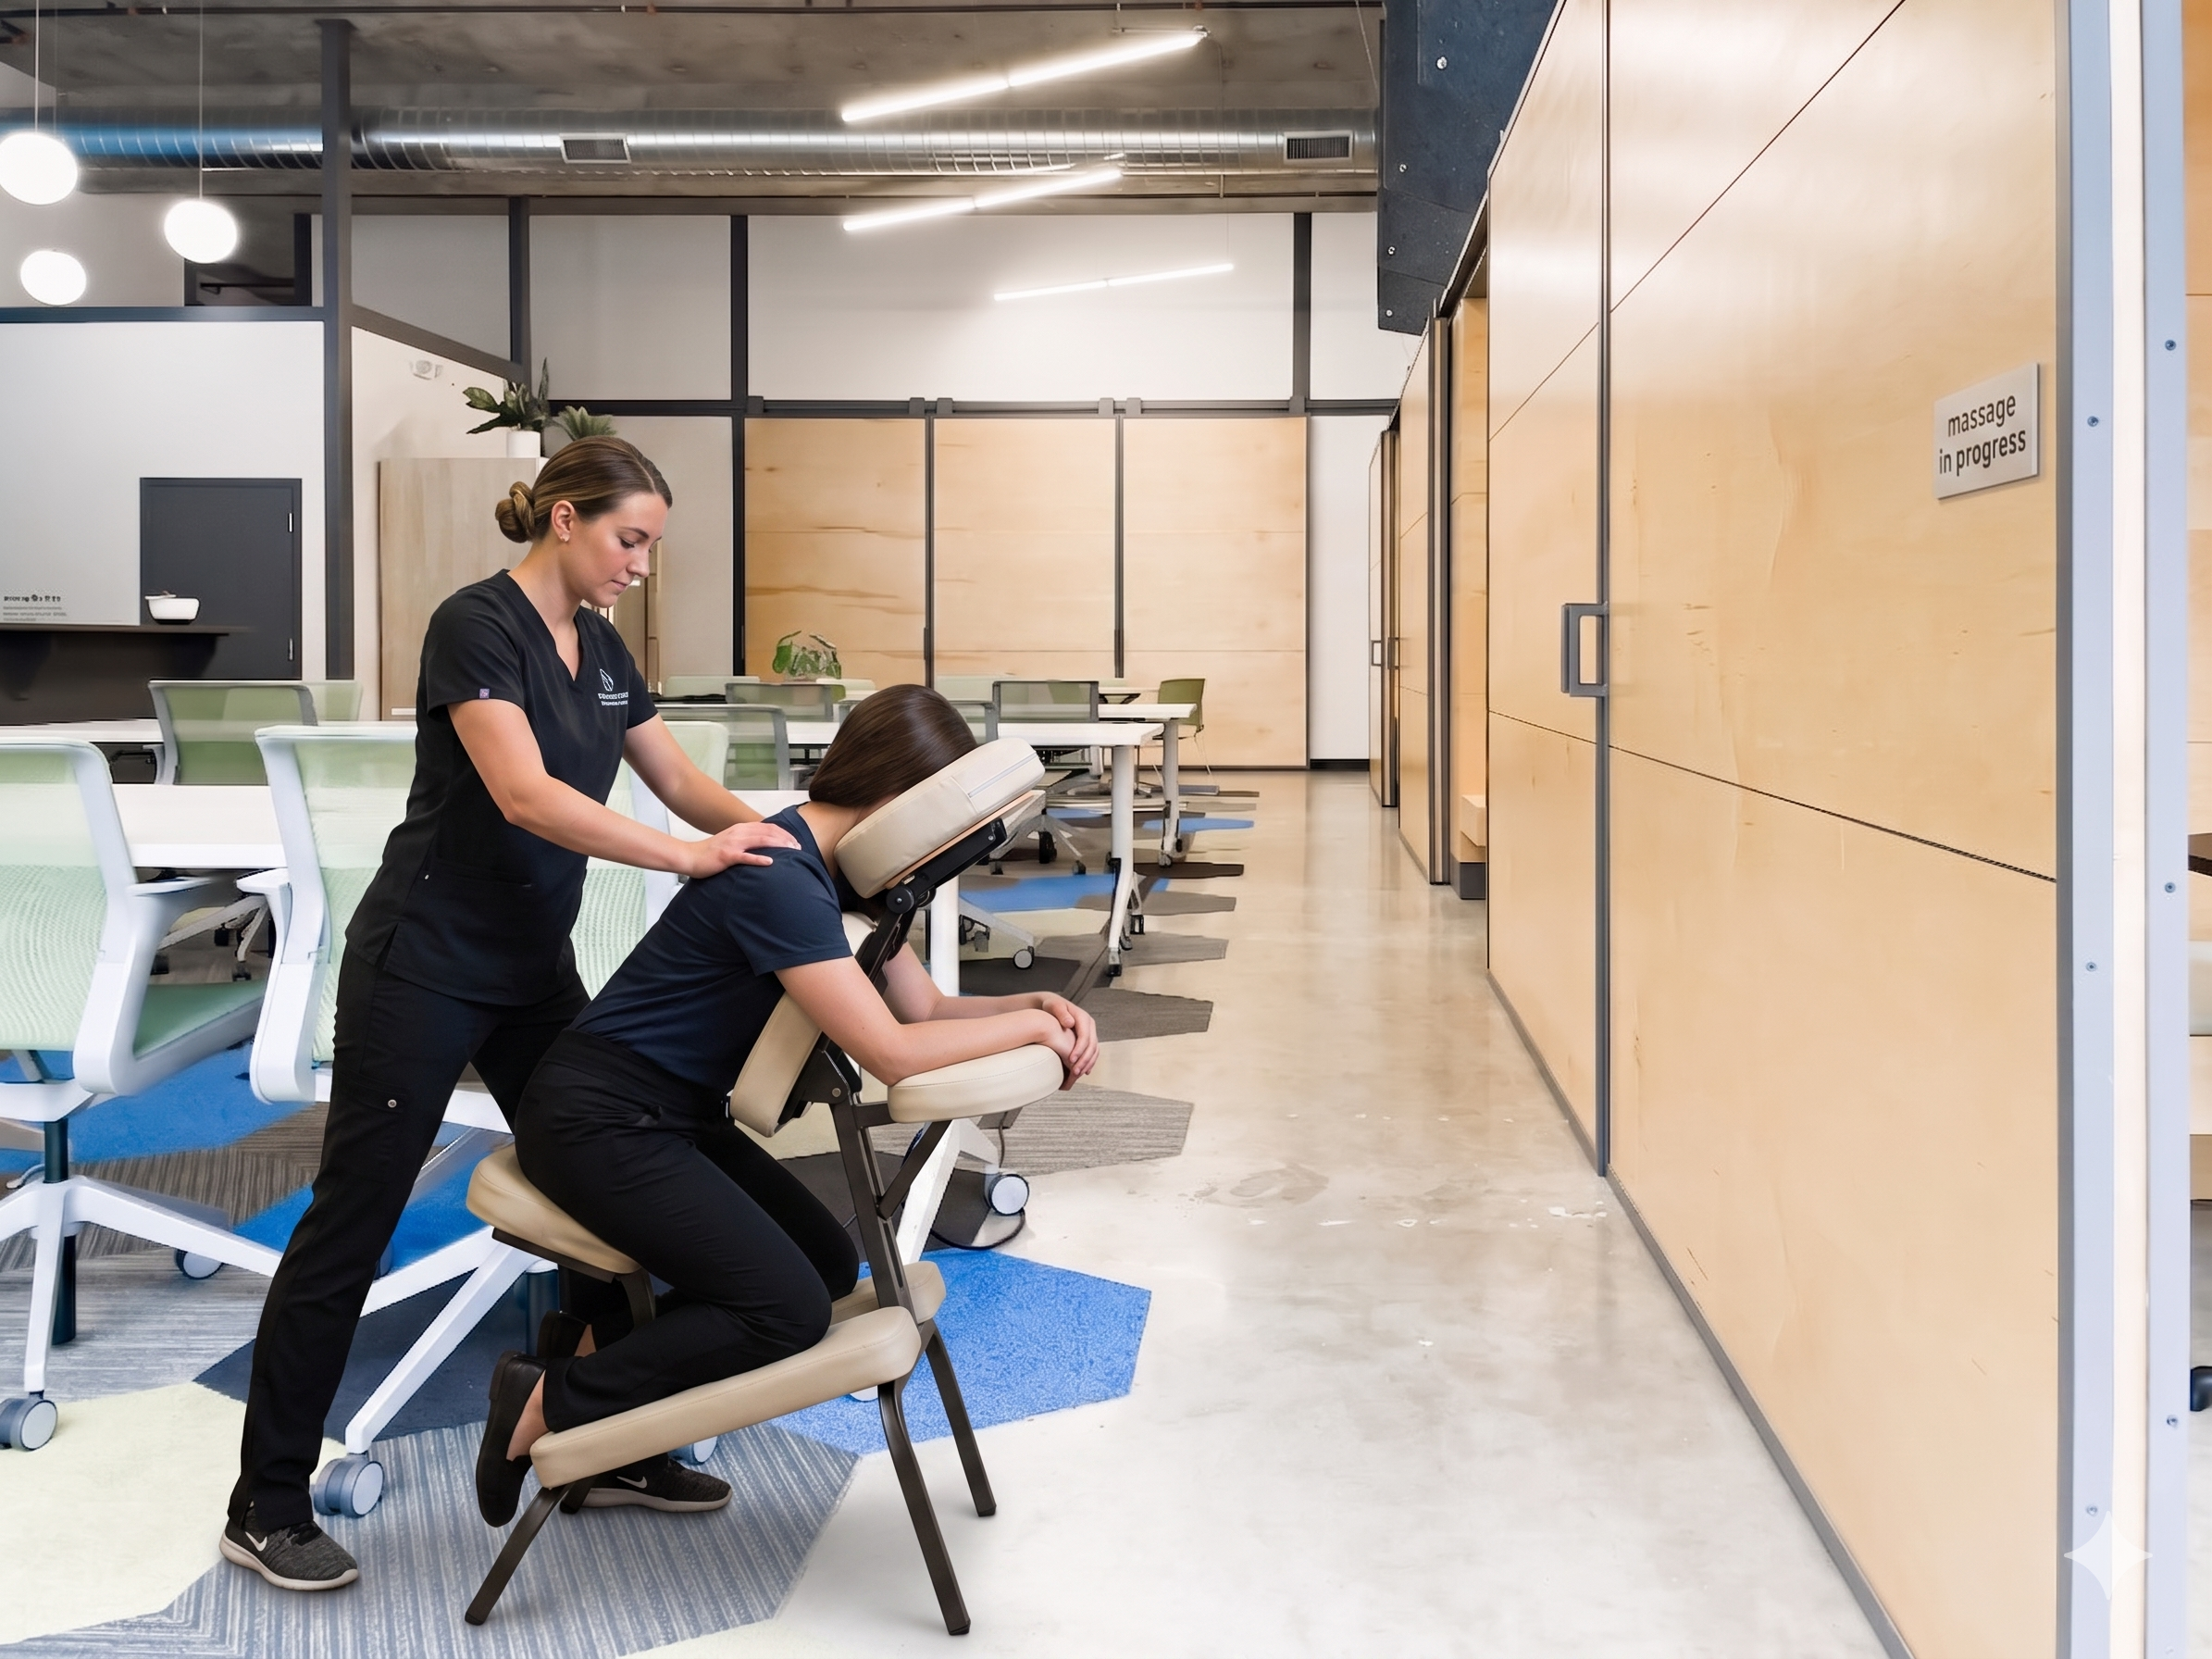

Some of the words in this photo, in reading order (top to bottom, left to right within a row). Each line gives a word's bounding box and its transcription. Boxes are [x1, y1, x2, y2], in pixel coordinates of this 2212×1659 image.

[1947, 395, 2016, 437] massage
[1939, 448, 1952, 474] in
[1957, 430, 2026, 477] progress
